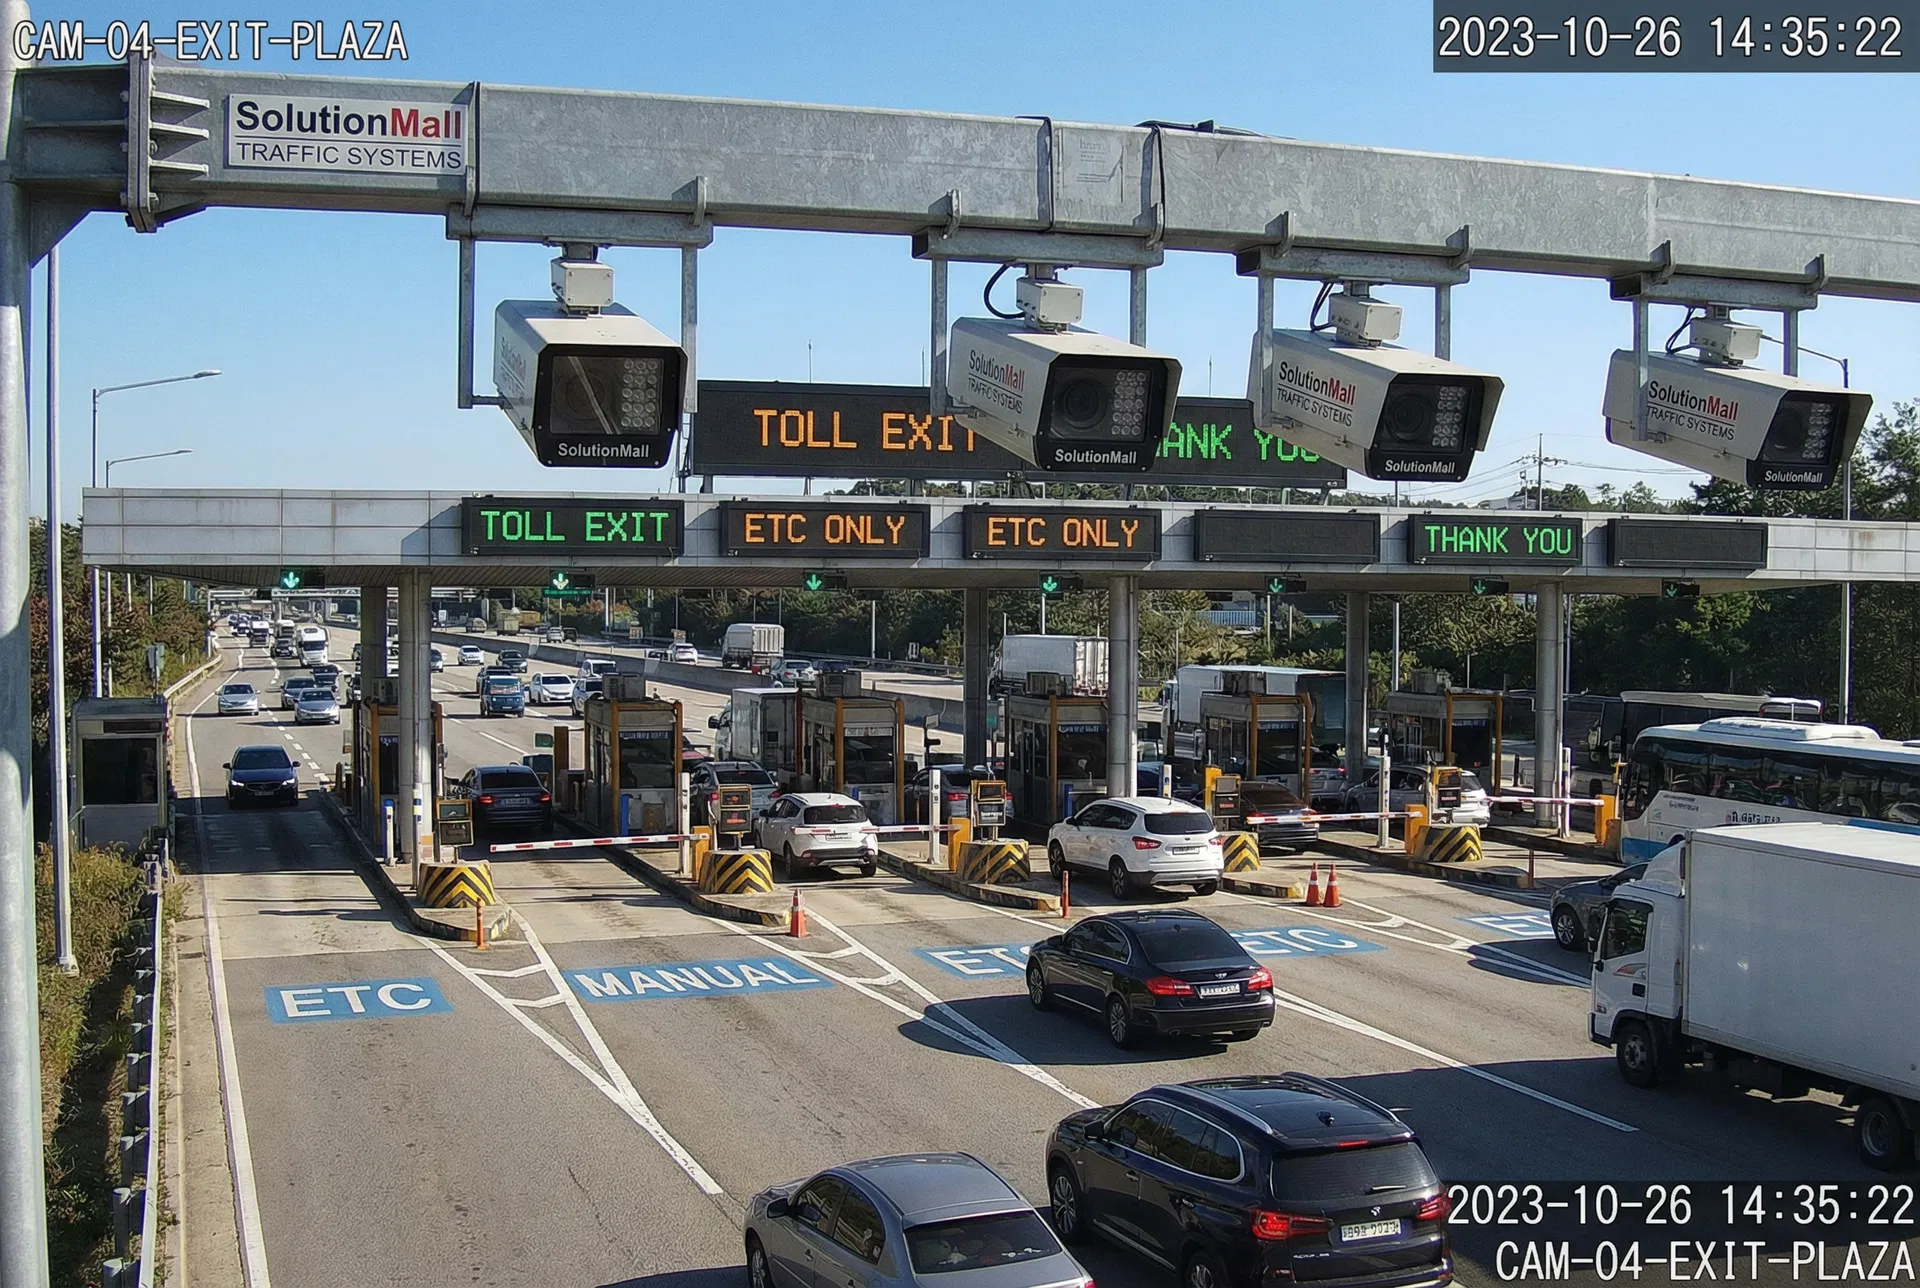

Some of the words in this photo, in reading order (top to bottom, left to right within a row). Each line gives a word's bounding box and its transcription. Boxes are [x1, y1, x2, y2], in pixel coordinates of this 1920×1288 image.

[236, 100, 461, 139] SolutionMall
[236, 142, 339, 164] TRAFFIC
[347, 147, 462, 169] SYSTEMS
[969, 349, 1026, 392] SolutionMall
[1279, 361, 1356, 406] SolutionMall
[1277, 387, 1310, 411] TRAFFIC
[1311, 401, 1353, 427] SYSTEMS
[1648, 380, 1739, 421] SolutionMall
[753, 409, 858, 448] TOLL
[1646, 405, 1686, 427] TRAFFIC
[1687, 416, 1735, 441] SYSTEMS
[558, 442, 650, 458] SolutionMall
[1055, 448, 1137, 465] SolutionMall
[1385, 458, 1456, 475] SolutionMall
[1764, 469, 1823, 484] SolutionMall
[480, 510, 566, 542] TOLL
[585, 511, 669, 543] EXIT
[744, 513, 807, 544] ETC
[824, 514, 906, 545] ONLY
[987, 516, 1046, 546] ETC
[1062, 517, 1140, 548] ONLY
[1424, 525, 1509, 554] THANK
[1522, 527, 1573, 555] YOU
[1467, 914, 1554, 936] ET
[926, 946, 1031, 975] ET
[574, 962, 820, 998] MANUAL
[279, 983, 432, 1018] ETC
